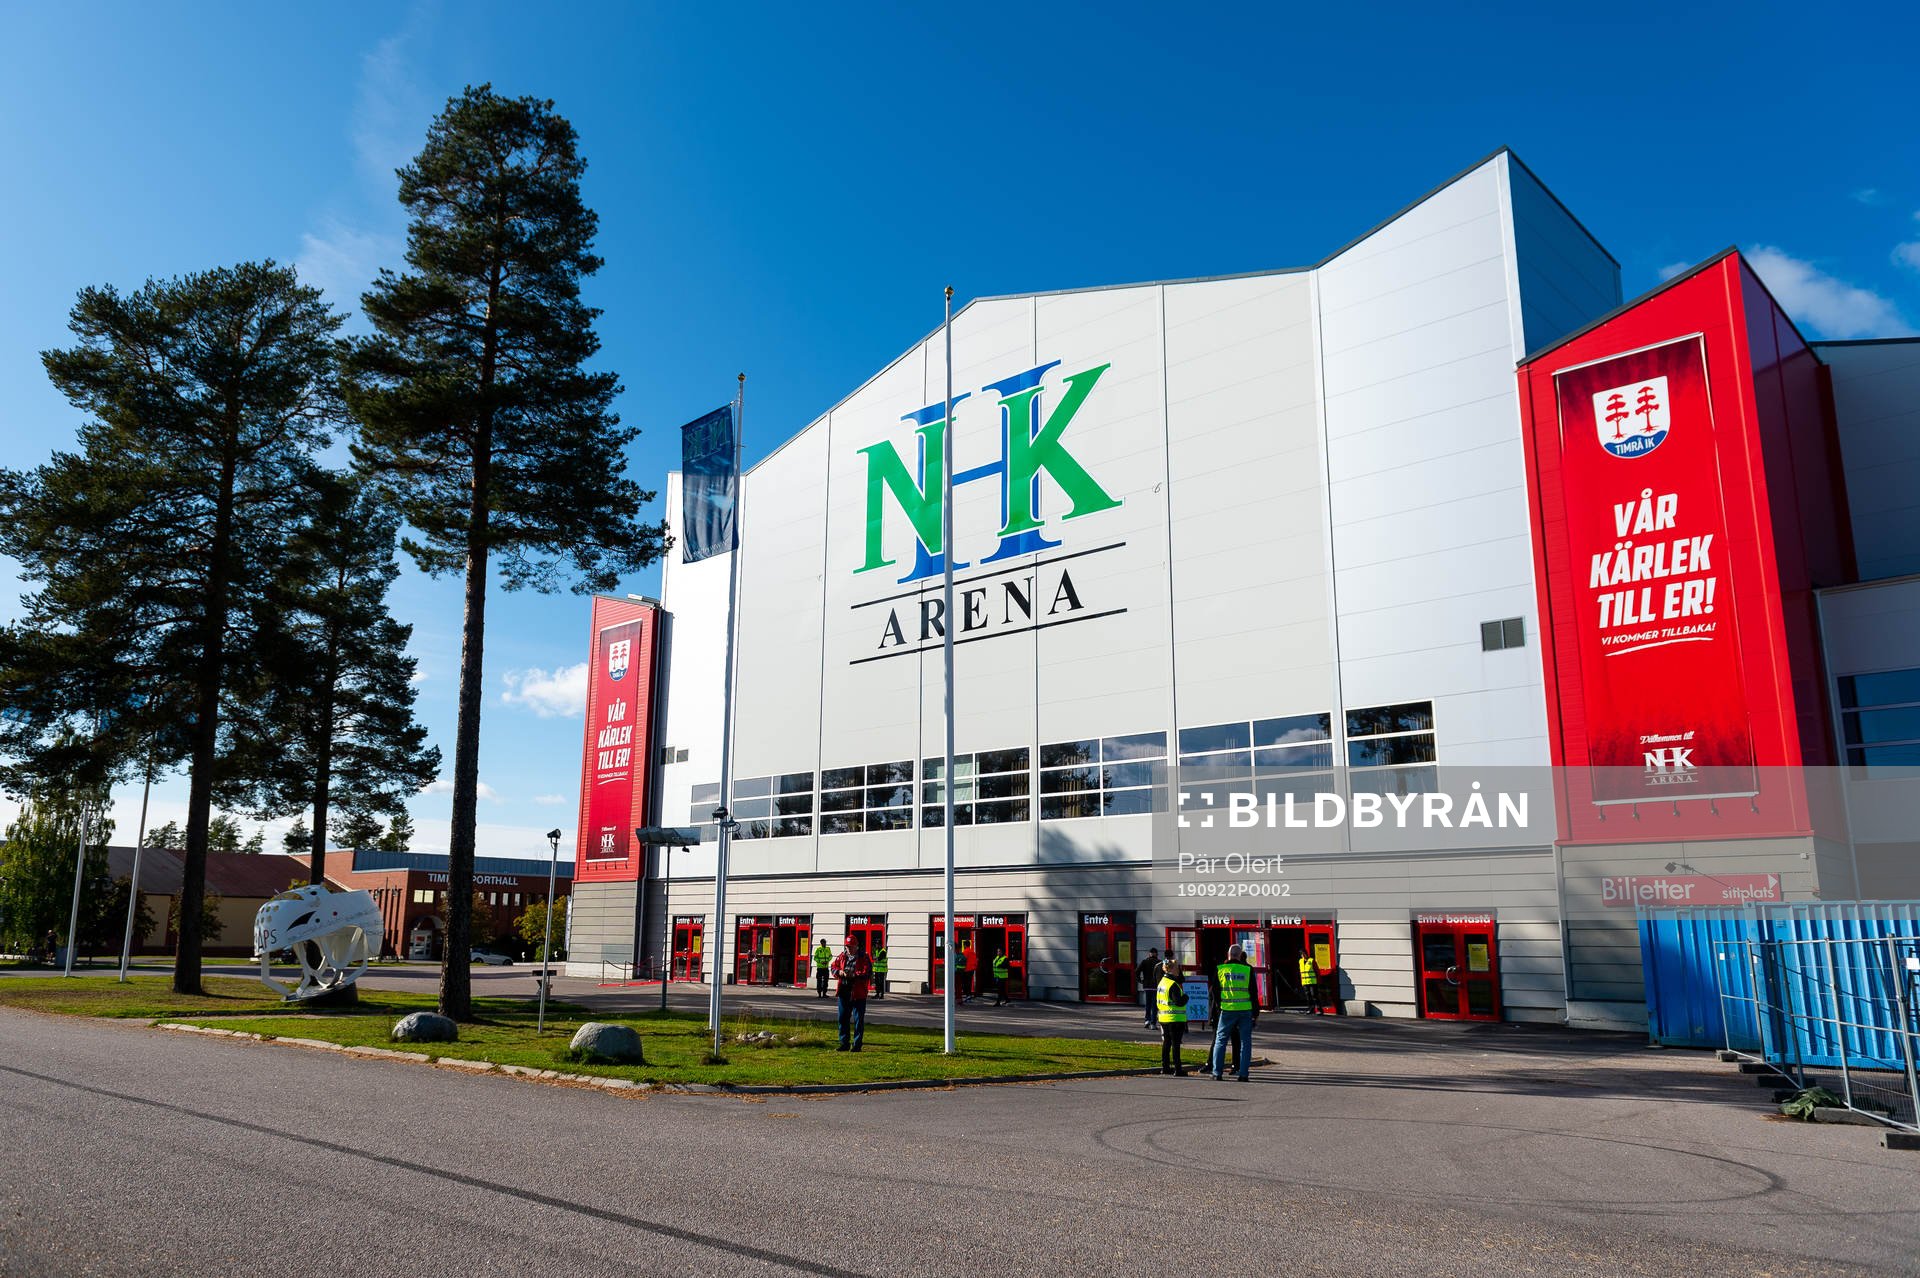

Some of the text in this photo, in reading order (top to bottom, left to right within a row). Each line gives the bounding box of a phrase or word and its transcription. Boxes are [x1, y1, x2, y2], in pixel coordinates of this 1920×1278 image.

[1615, 437, 1655, 455] TIMRÅ IK
[1613, 488, 1678, 538] VÅR
[1589, 534, 1714, 589] KÄRLEK
[878, 568, 1084, 649] ARENA
[1597, 578, 1717, 628] TILL ER!
[1601, 622, 1717, 645] VI KOMMER TILLBAKA!
[607, 697, 627, 723] VÅR
[597, 725, 633, 749] KÄRLEK
[597, 748, 631, 771] TILL ER!
[1650, 775, 1693, 785] ARENA
[1602, 877, 1775, 904] Biljetter sittplats
[1084, 914, 1109, 925] Entré
[1202, 914, 1231, 925] Entré
[1270, 914, 1302, 925] Entré
